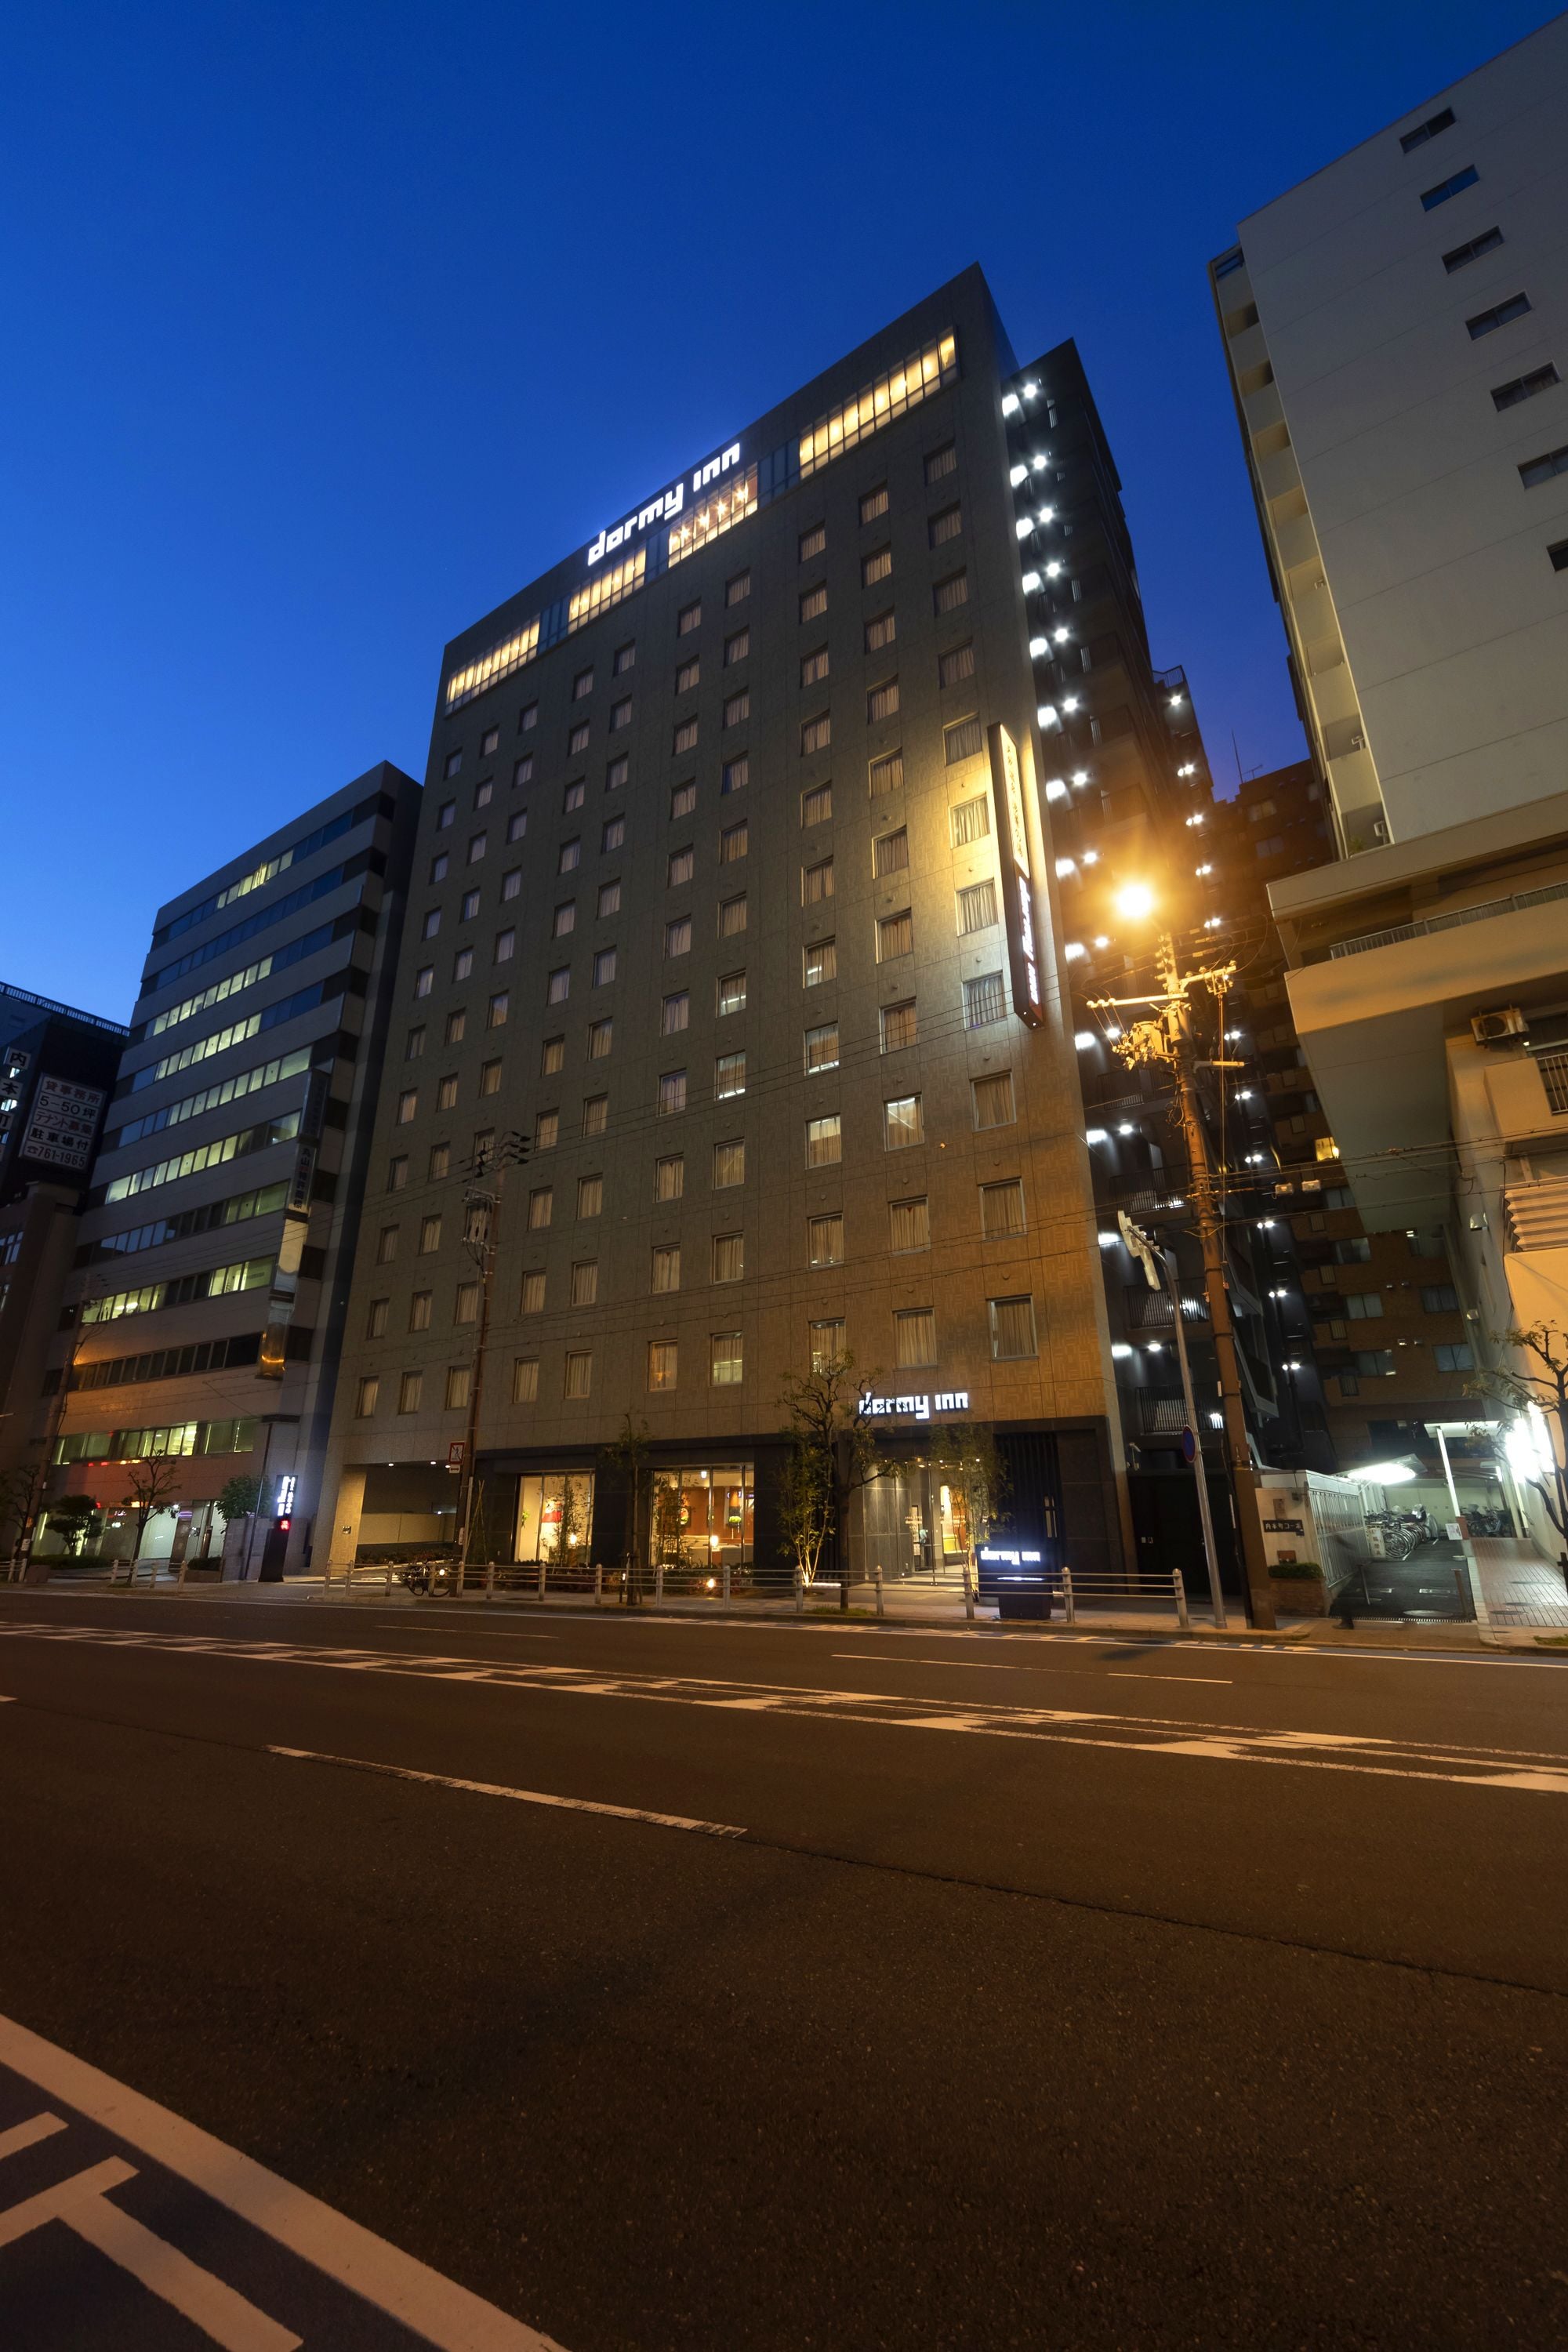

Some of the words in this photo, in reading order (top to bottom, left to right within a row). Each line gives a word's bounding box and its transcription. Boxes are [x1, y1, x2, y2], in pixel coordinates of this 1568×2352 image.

[587, 481, 684, 567] dormy
[693, 442, 740, 492] inn
[45, 1080, 100, 1104] 貸事務所
[35, 1110, 93, 1135] テナント募集
[30, 1127, 89, 1151] 駐車場付
[858, 1392, 930, 1420] dormy
[935, 1392, 969, 1410] inn
[980, 1546, 1021, 1566] dormy
